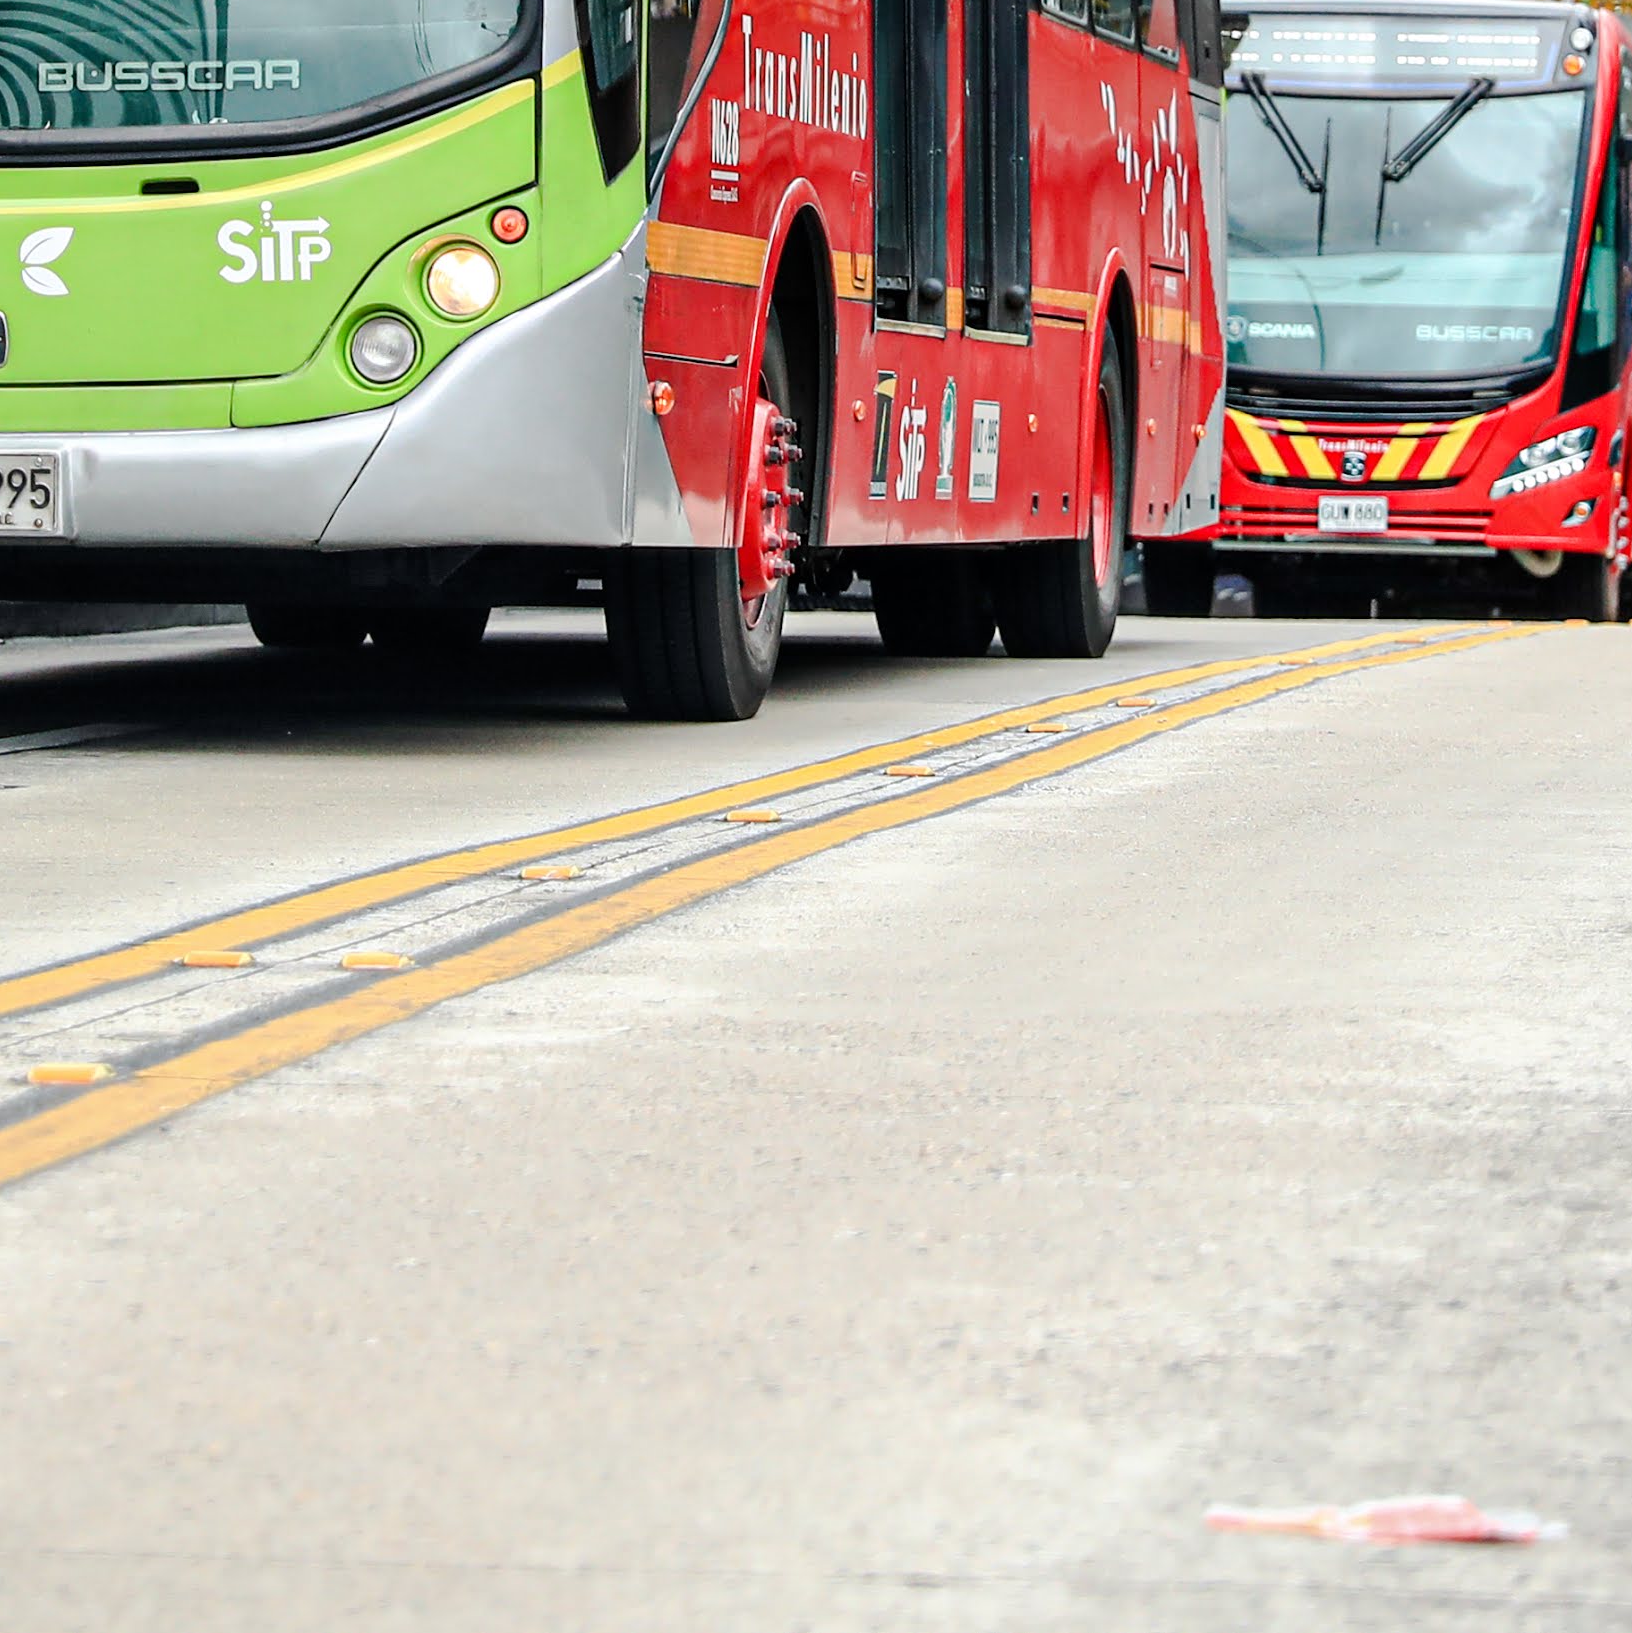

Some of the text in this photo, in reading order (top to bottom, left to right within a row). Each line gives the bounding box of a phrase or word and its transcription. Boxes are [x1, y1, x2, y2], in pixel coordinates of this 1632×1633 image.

[38, 59, 300, 92] BUSSCAR
[742, 13, 867, 141] TransMilenio
[711, 98, 740, 167] N628
[1248, 321, 1316, 340] SCANIA
[1416, 324, 1534, 343] BUSSCAR
